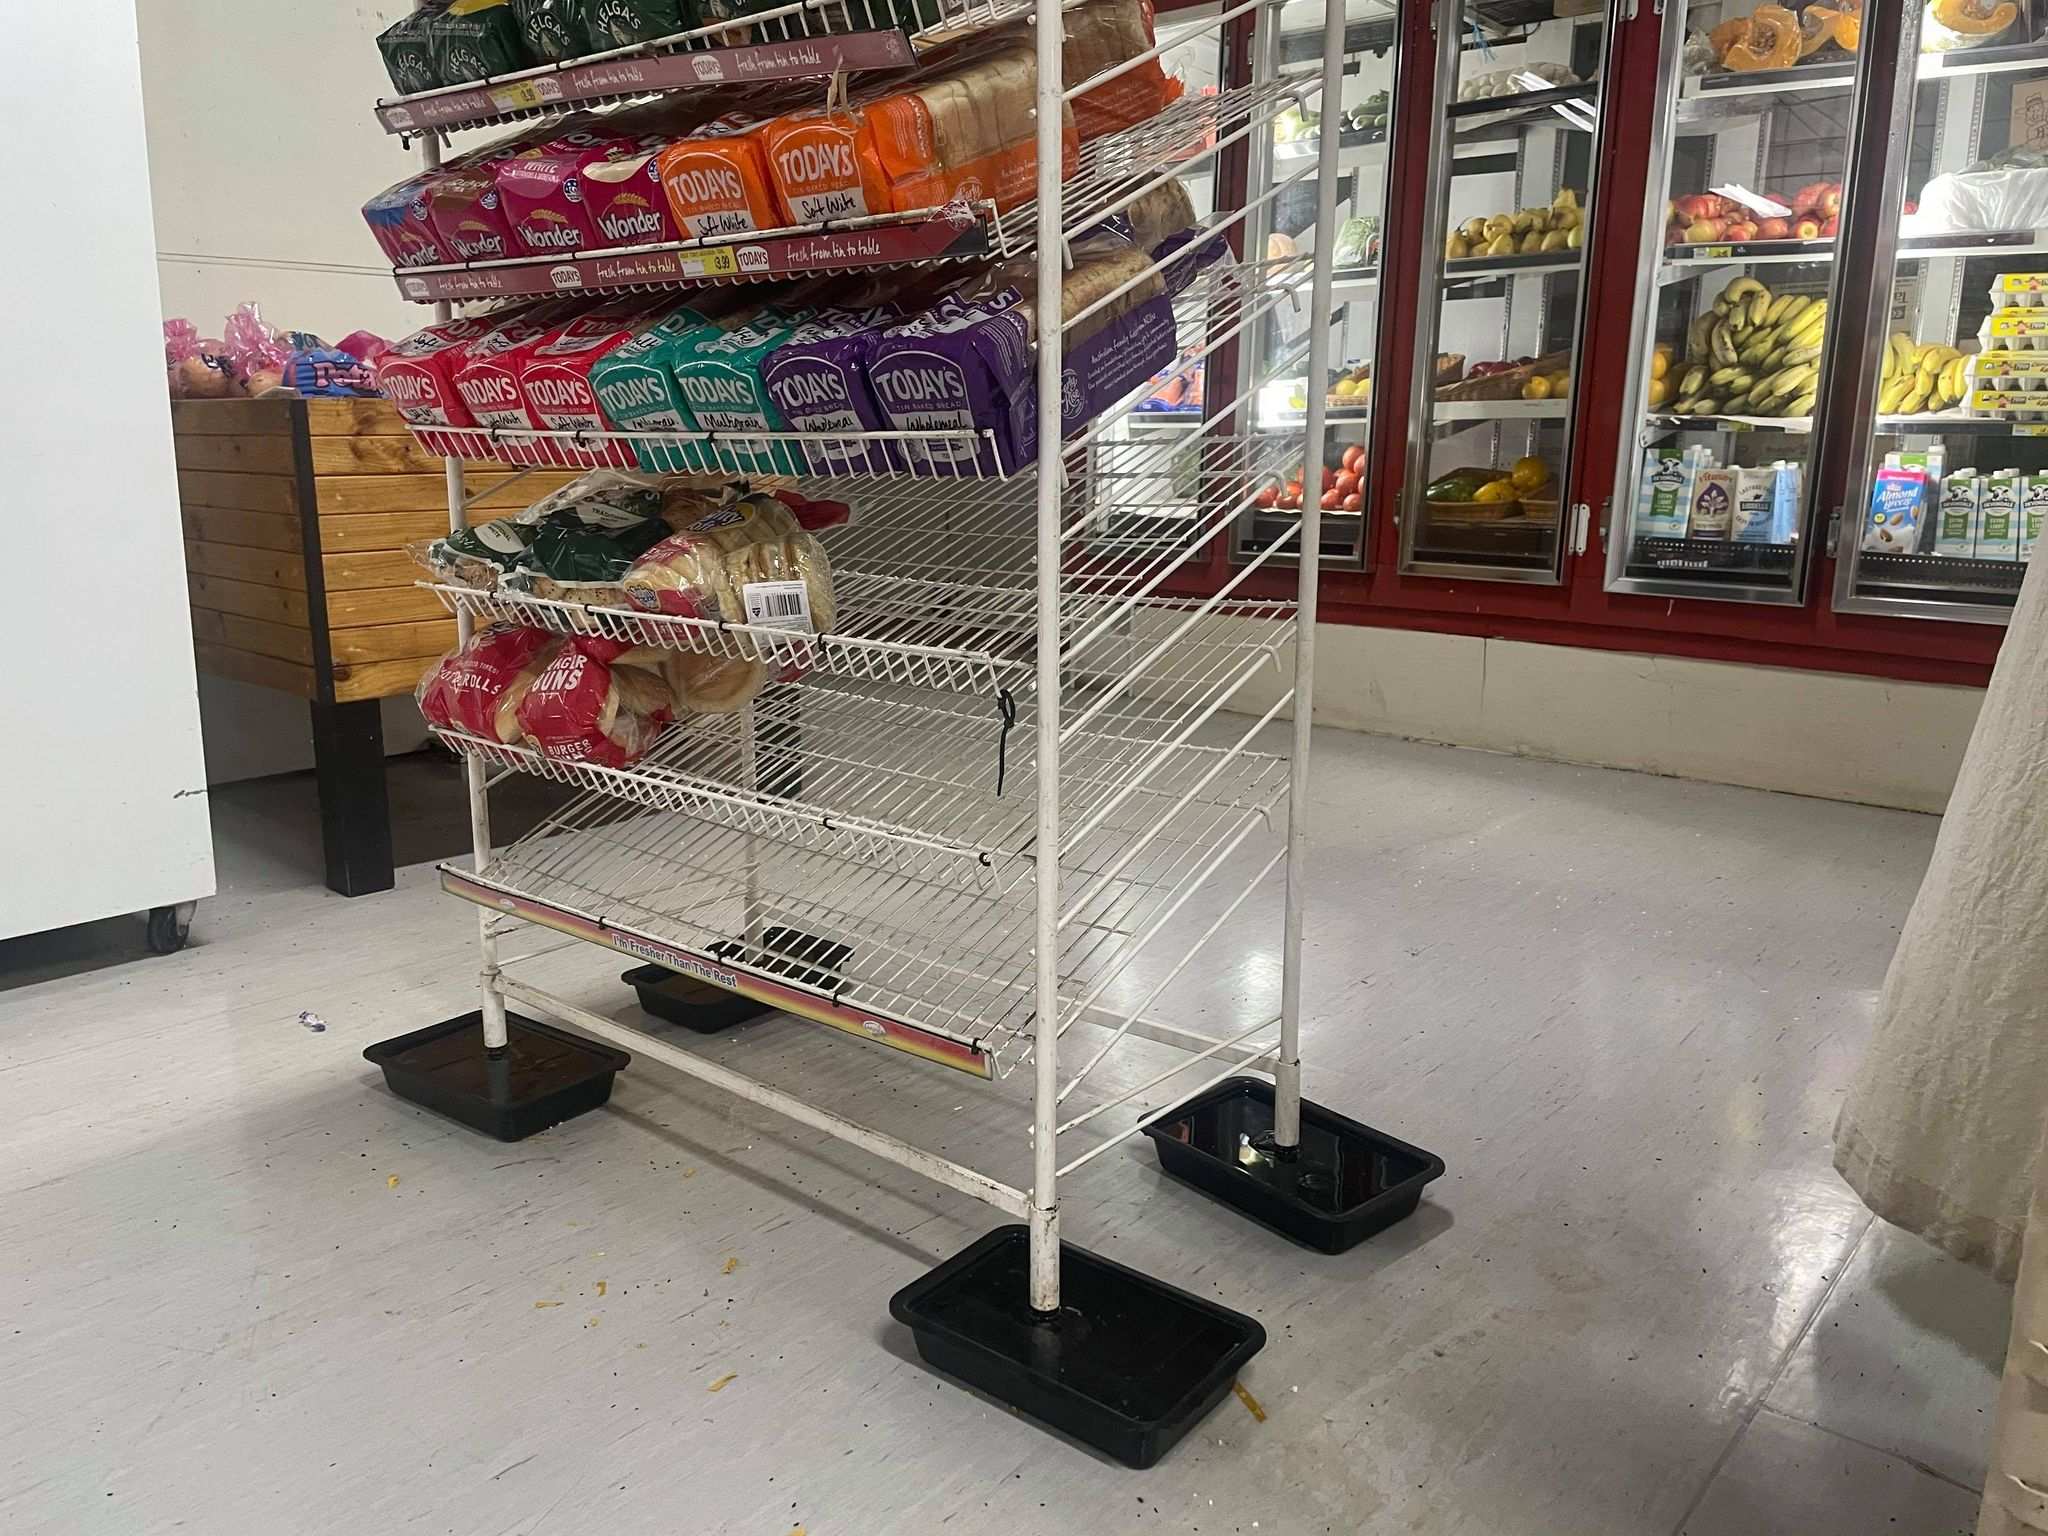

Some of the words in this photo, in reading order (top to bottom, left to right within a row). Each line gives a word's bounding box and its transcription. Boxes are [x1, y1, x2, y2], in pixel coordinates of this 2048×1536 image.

[528, 15, 570, 46] HELGA'S
[598, 0, 641, 34] HELGA'S
[449, 47, 489, 76] HELGA'S
[779, 140, 854, 184] TODAY'S
[669, 167, 742, 205] TODAY'S
[517, 223, 580, 248] Wonder
[597, 208, 662, 241] Wonder
[450, 233, 502, 259] Wonder
[787, 243, 810, 269] fresh
[809, 240, 832, 267] from
[831, 239, 847, 261] tin
[846, 240, 857, 258] to
[856, 235, 882, 258] table
[596, 261, 618, 284] fresh
[615, 260, 636, 282] from
[634, 260, 649, 276] tin
[648, 261, 658, 274] to
[656, 257, 677, 274] table
[383, 374, 436, 400] TODAY'S
[457, 374, 517, 405] TODAY'S
[525, 378, 591, 406] TODAY'S
[599, 376, 665, 412] TODAY'S
[678, 377, 754, 410] TODAY'S
[772, 369, 846, 410] TODAY'S
[876, 366, 965, 404] TODAY'S
[905, 411, 964, 430] Wholemeal
[462, 673, 502, 696] ROLLS
[547, 739, 592, 756] BURGER
[613, 934, 628, 948] I'm
[630, 940, 665, 961] Fresher
[666, 953, 691, 971] Than
[691, 961, 712, 979] The
[712, 969, 737, 988] Rest
